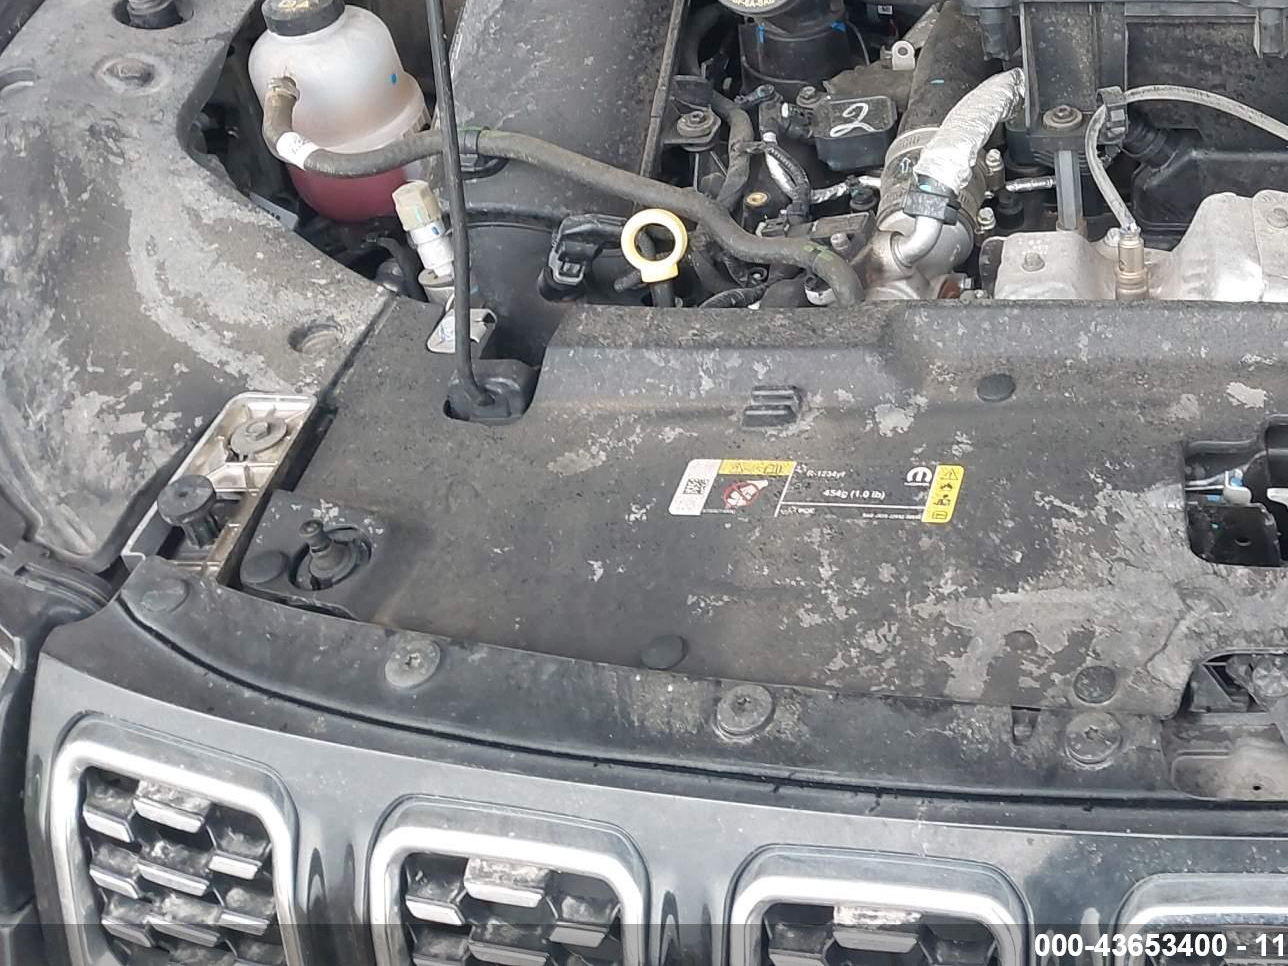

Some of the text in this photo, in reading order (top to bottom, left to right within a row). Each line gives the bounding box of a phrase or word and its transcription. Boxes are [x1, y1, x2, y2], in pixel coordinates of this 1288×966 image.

[822, 489, 886, 500] 454g (1.0 lb)
